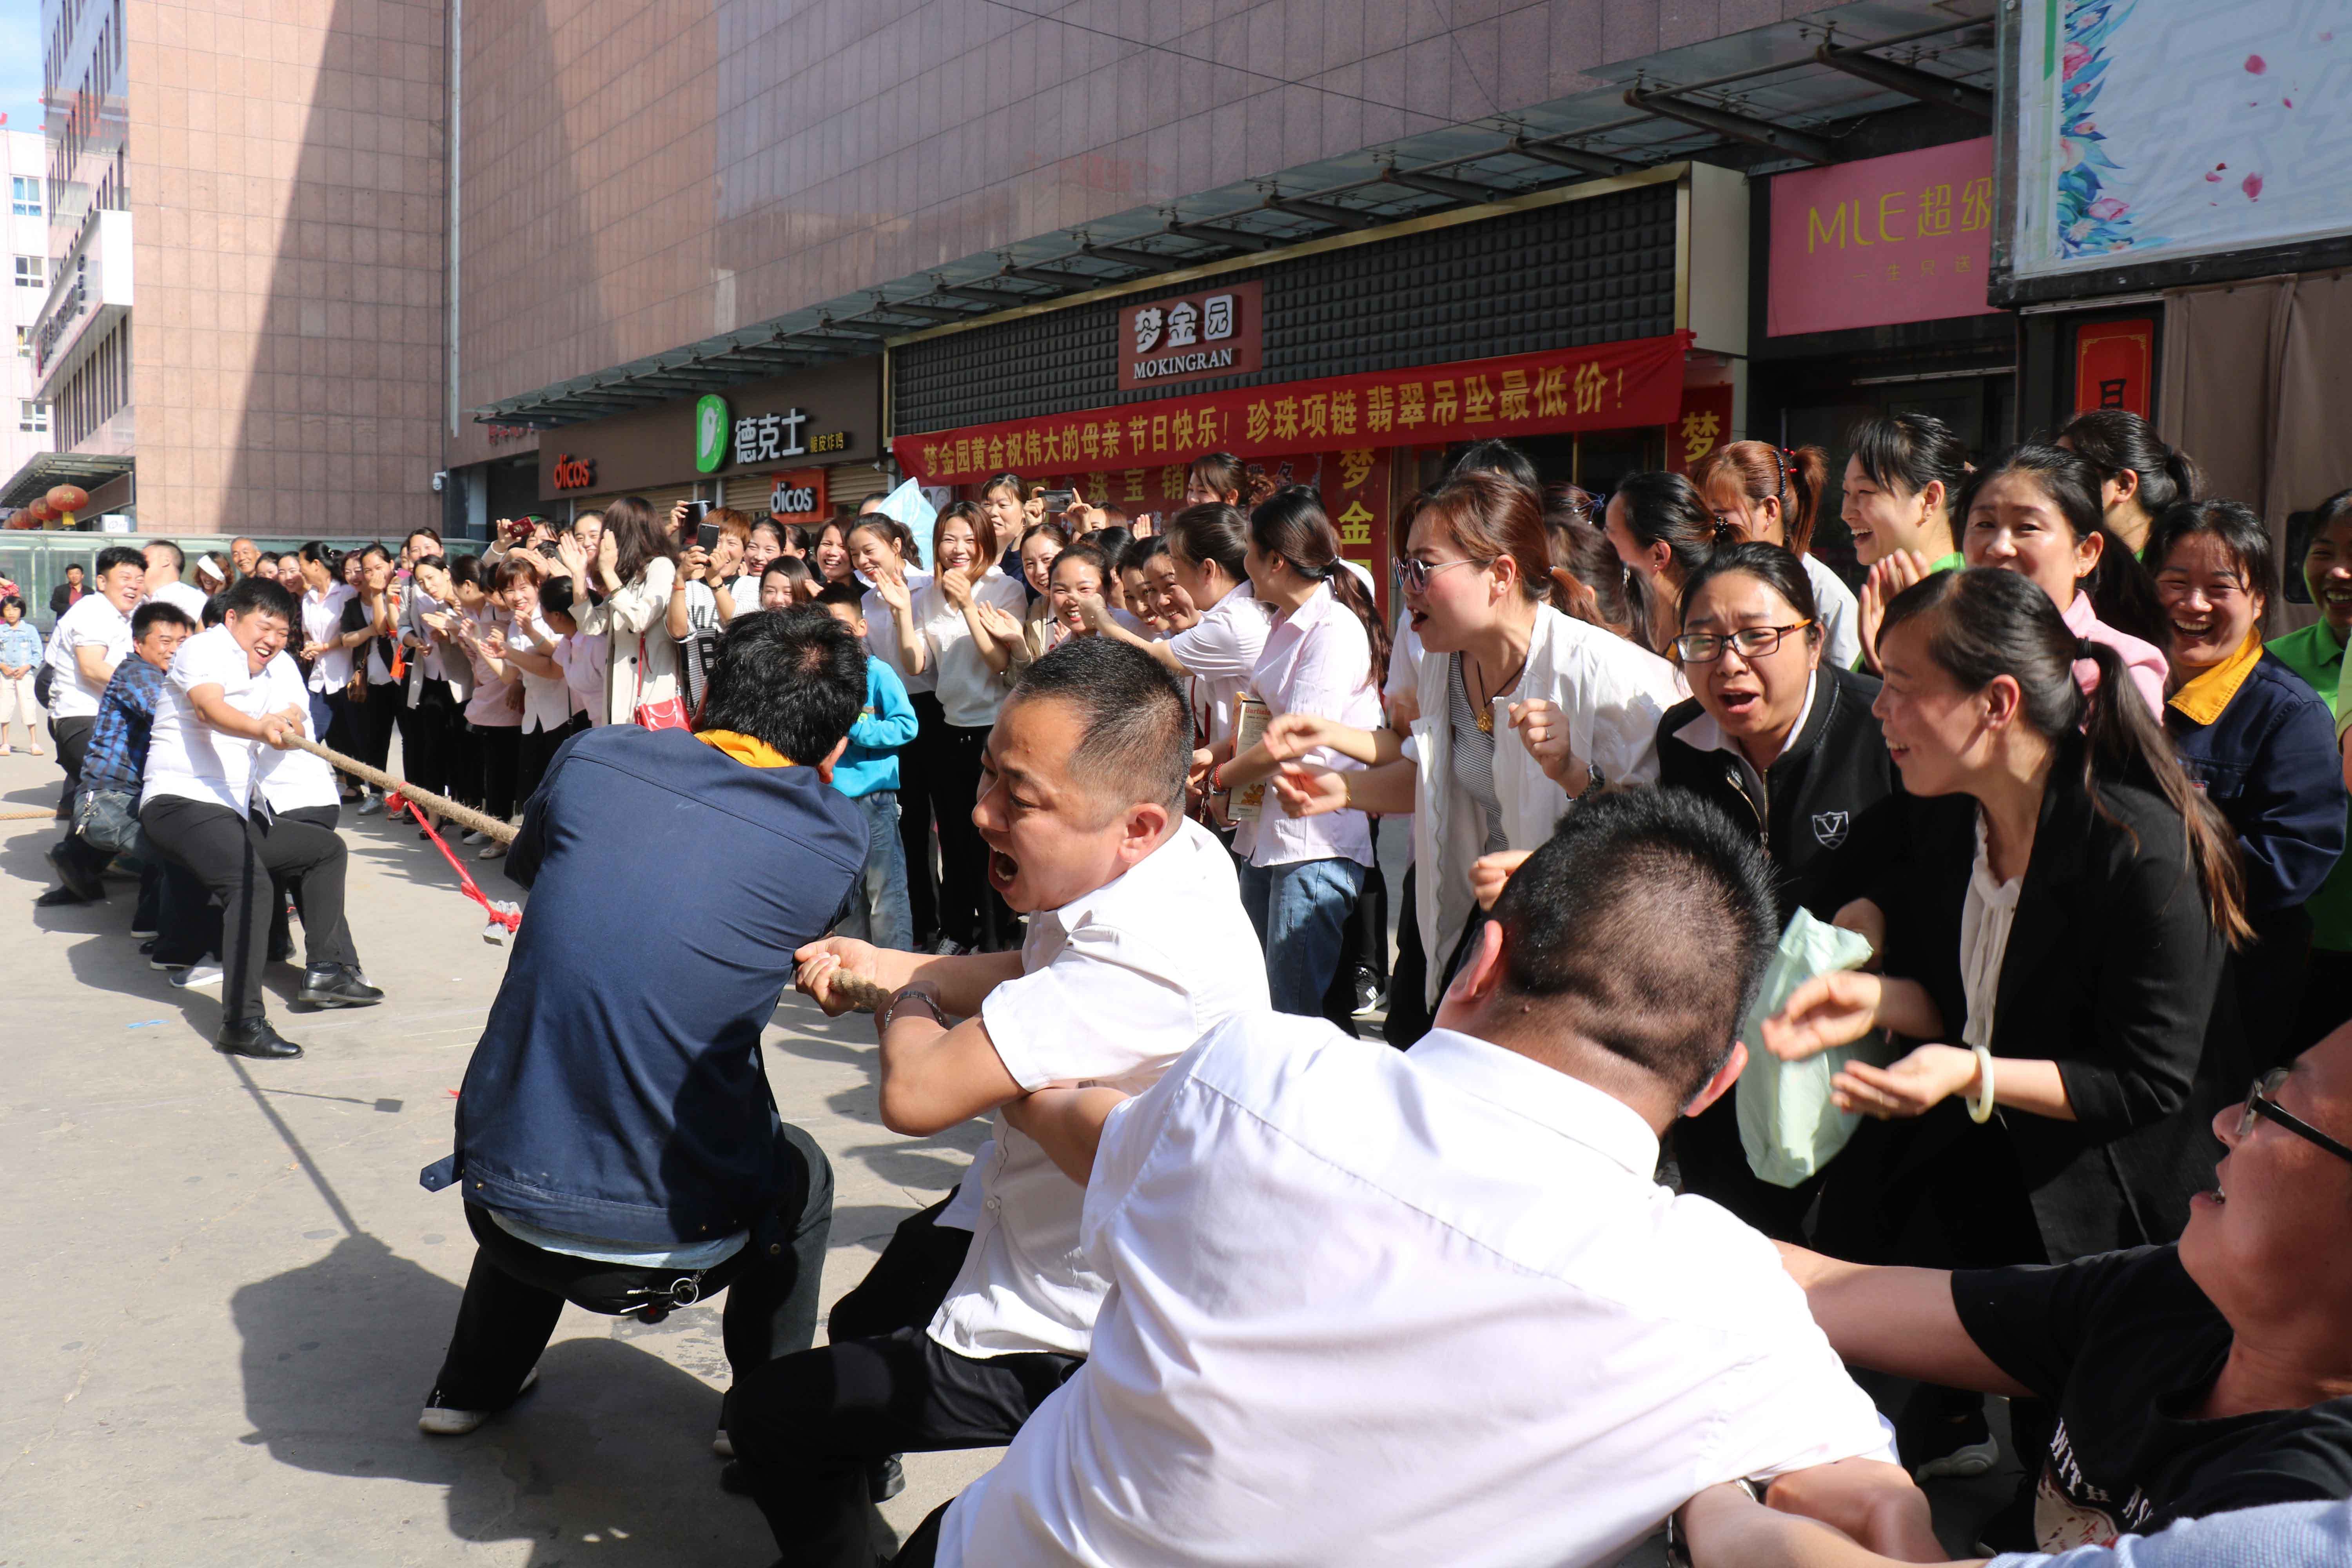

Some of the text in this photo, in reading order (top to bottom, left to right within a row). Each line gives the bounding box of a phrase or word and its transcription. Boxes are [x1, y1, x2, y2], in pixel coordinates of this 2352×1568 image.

[1808, 177, 1992, 254] MLE 超级
[1134, 294, 1233, 354] 梦金园
[1133, 348, 1233, 379] MOKINGRAN
[735, 408, 806, 464] 德克士
[1680, 410, 1720, 462] 梦
[554, 454, 590, 489] dicos
[771, 482, 813, 513] dicos
